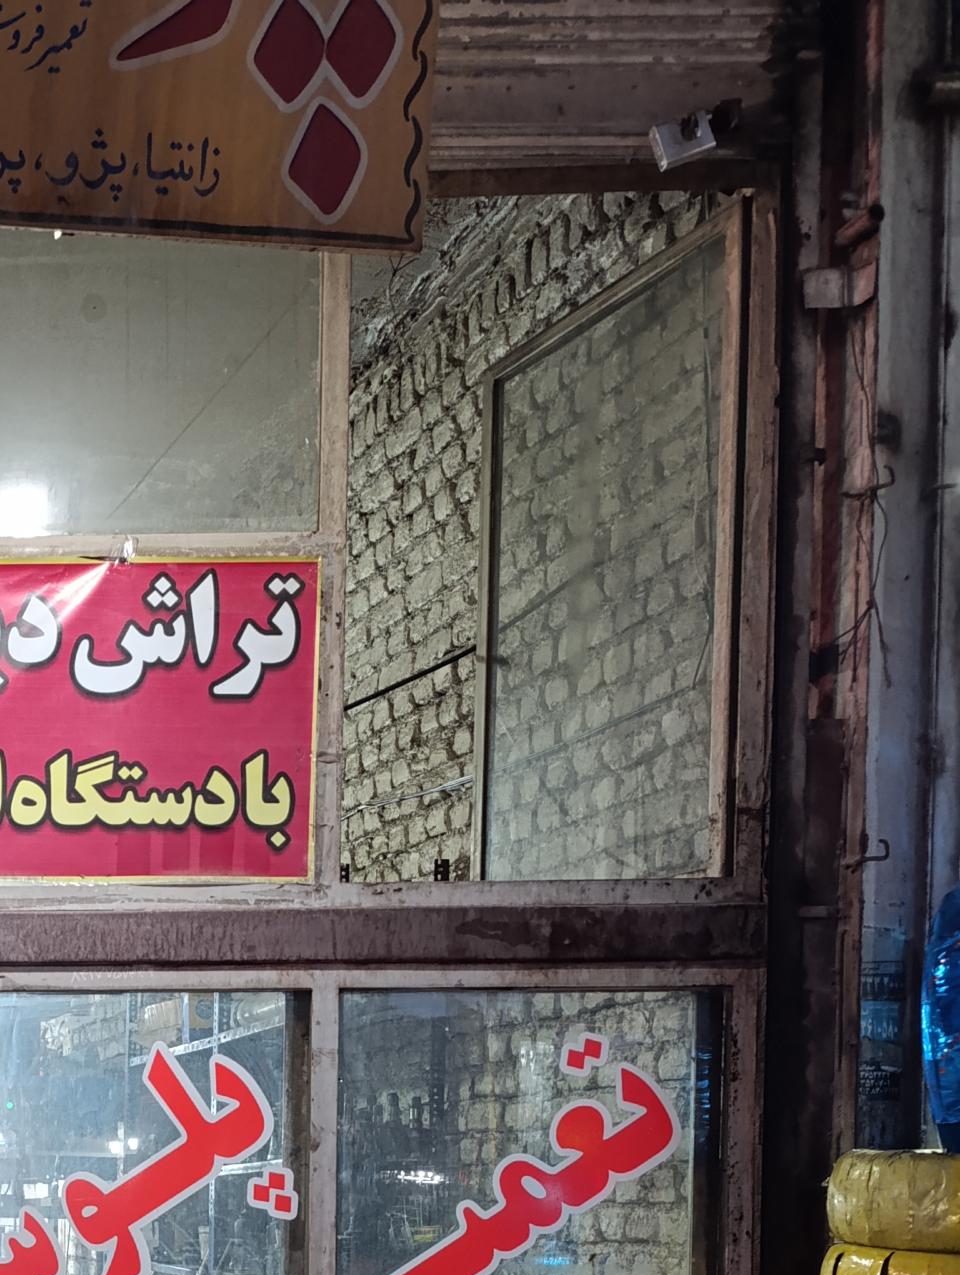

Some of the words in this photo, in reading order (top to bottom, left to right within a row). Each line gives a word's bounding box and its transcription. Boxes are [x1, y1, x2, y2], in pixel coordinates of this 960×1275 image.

[71, 569, 303, 697] تراش
[11, 751, 237, 832] دستگاه
[243, 751, 296, 849] با
